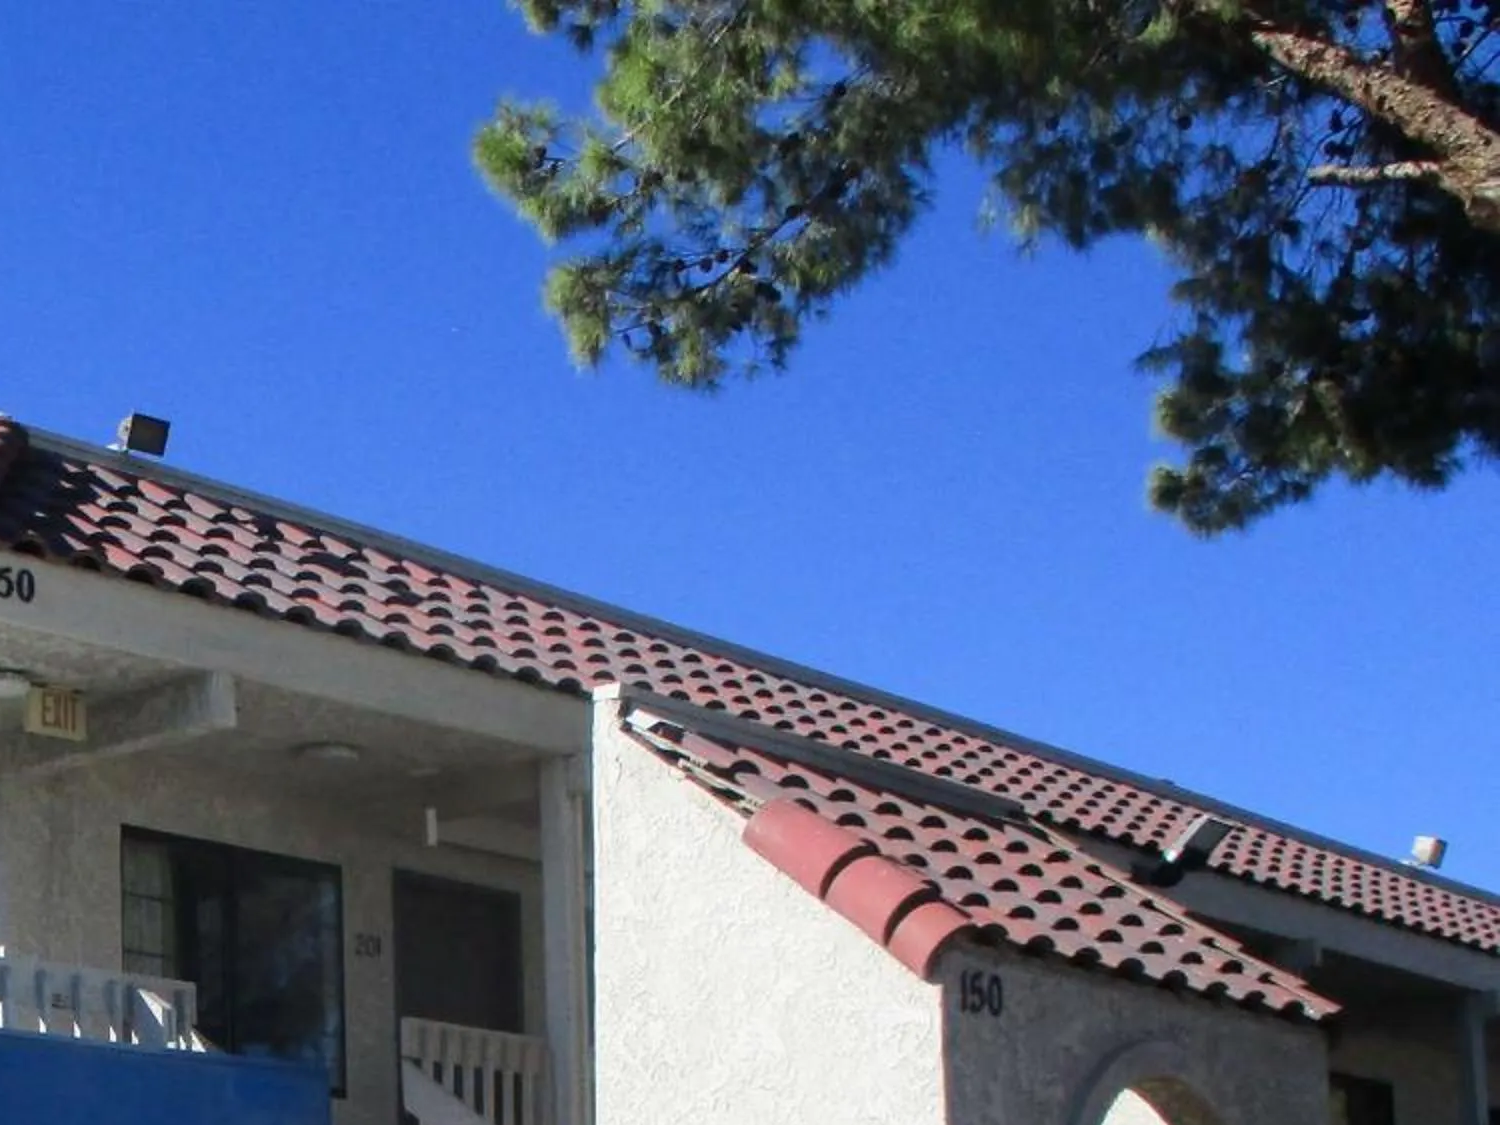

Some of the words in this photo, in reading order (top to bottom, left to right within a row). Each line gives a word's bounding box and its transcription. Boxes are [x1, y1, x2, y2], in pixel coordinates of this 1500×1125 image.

[41, 689, 77, 733] EXIT
[355, 932, 381, 958] 201
[960, 969, 1003, 1017] 150
